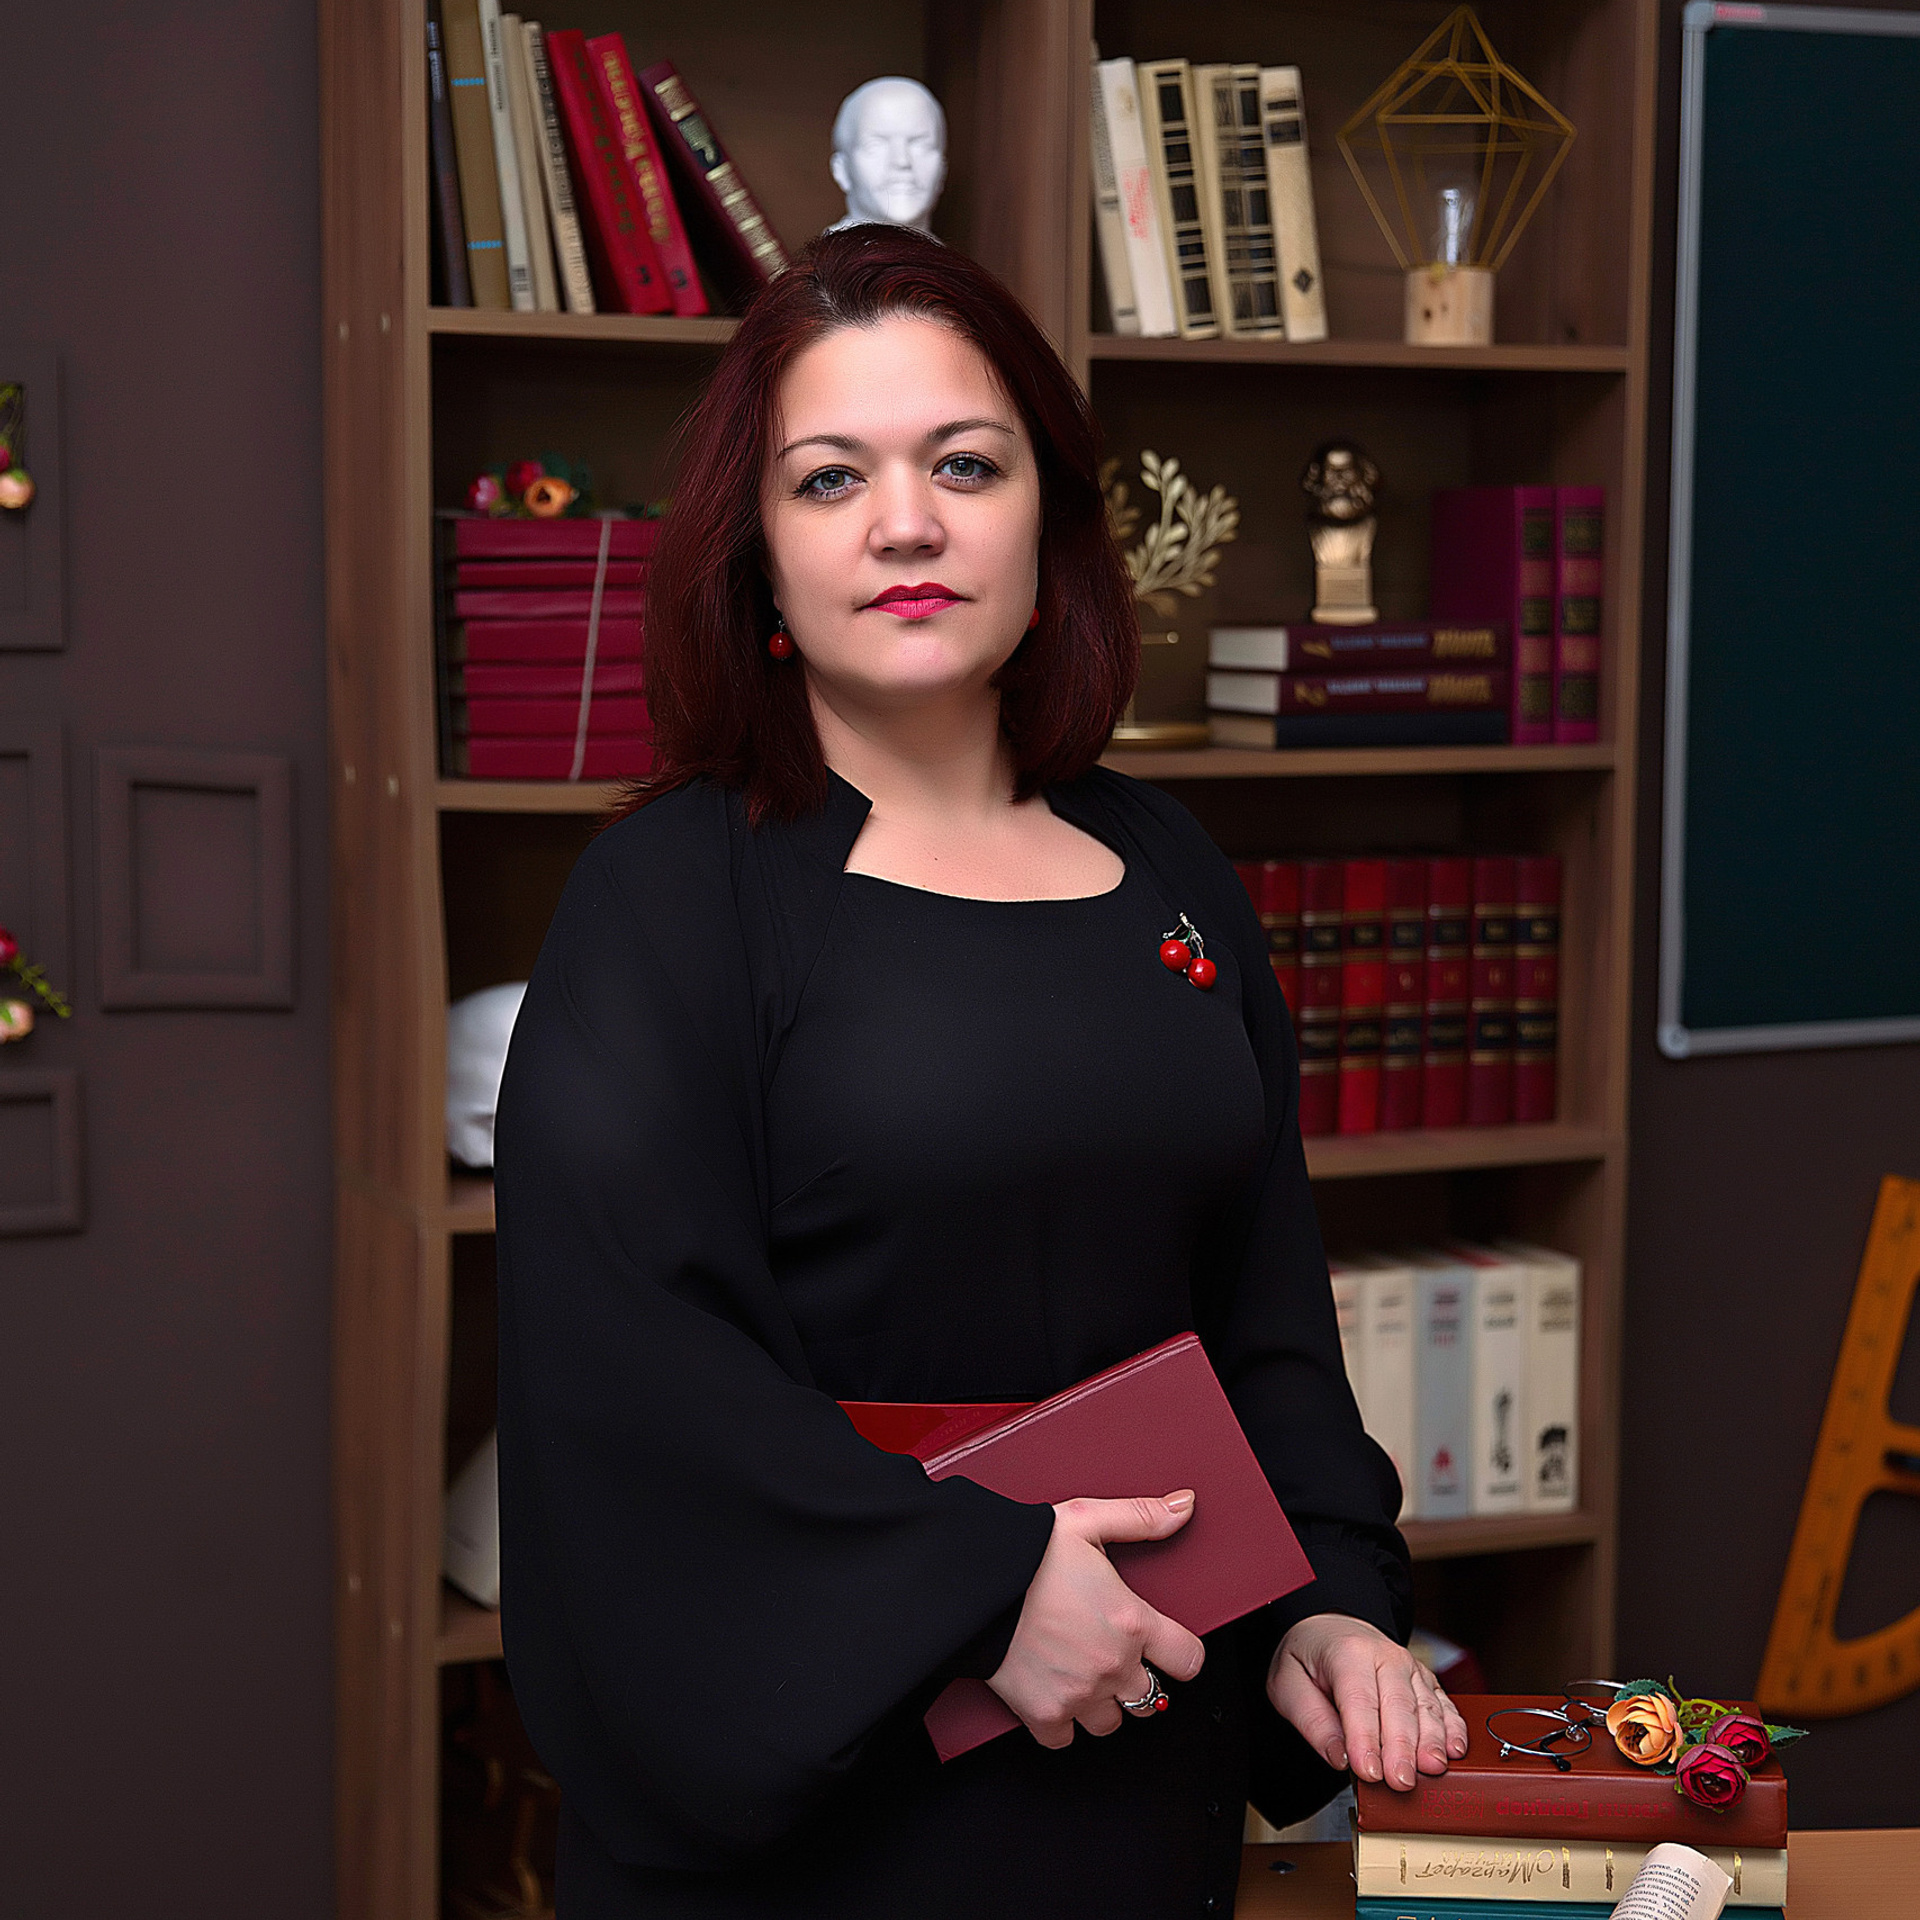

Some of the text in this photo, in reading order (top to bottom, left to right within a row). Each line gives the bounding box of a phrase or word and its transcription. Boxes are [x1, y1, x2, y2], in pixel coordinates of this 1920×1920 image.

[1496, 1797, 1589, 1819] Гарднер
[1415, 1852, 1555, 1885] Маргарет
[1674, 1868, 1690, 1879] Для
